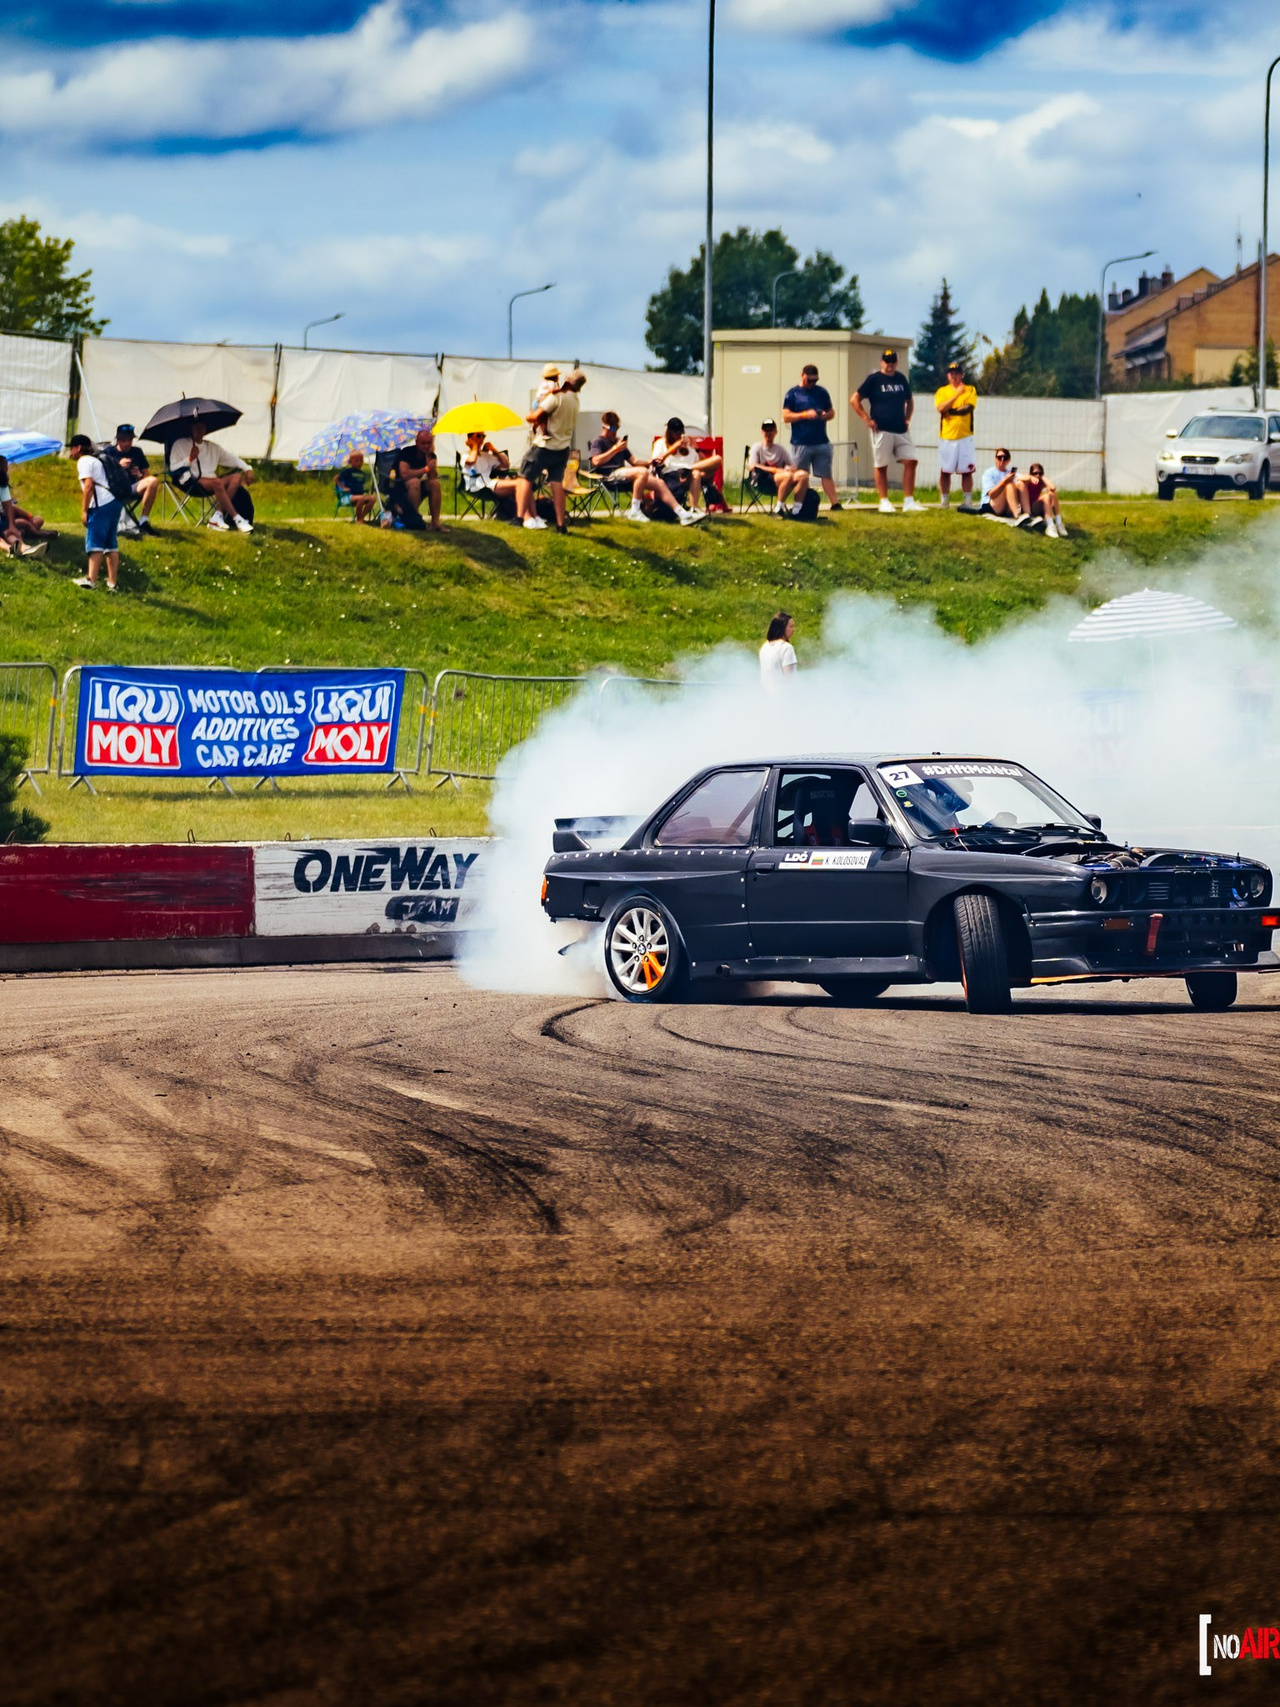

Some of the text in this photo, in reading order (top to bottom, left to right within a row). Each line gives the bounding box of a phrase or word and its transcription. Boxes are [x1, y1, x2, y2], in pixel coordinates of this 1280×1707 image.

[94, 683, 179, 724] LIQUI
[188, 689, 306, 715] MOTOR OILS
[314, 686, 391, 724] LIQUI
[92, 724, 176, 764] MOLY
[191, 717, 300, 742] ADDITIVES
[308, 724, 390, 761] MOLY
[196, 743, 296, 768] CAR CARE
[889, 771, 910, 781] 27
